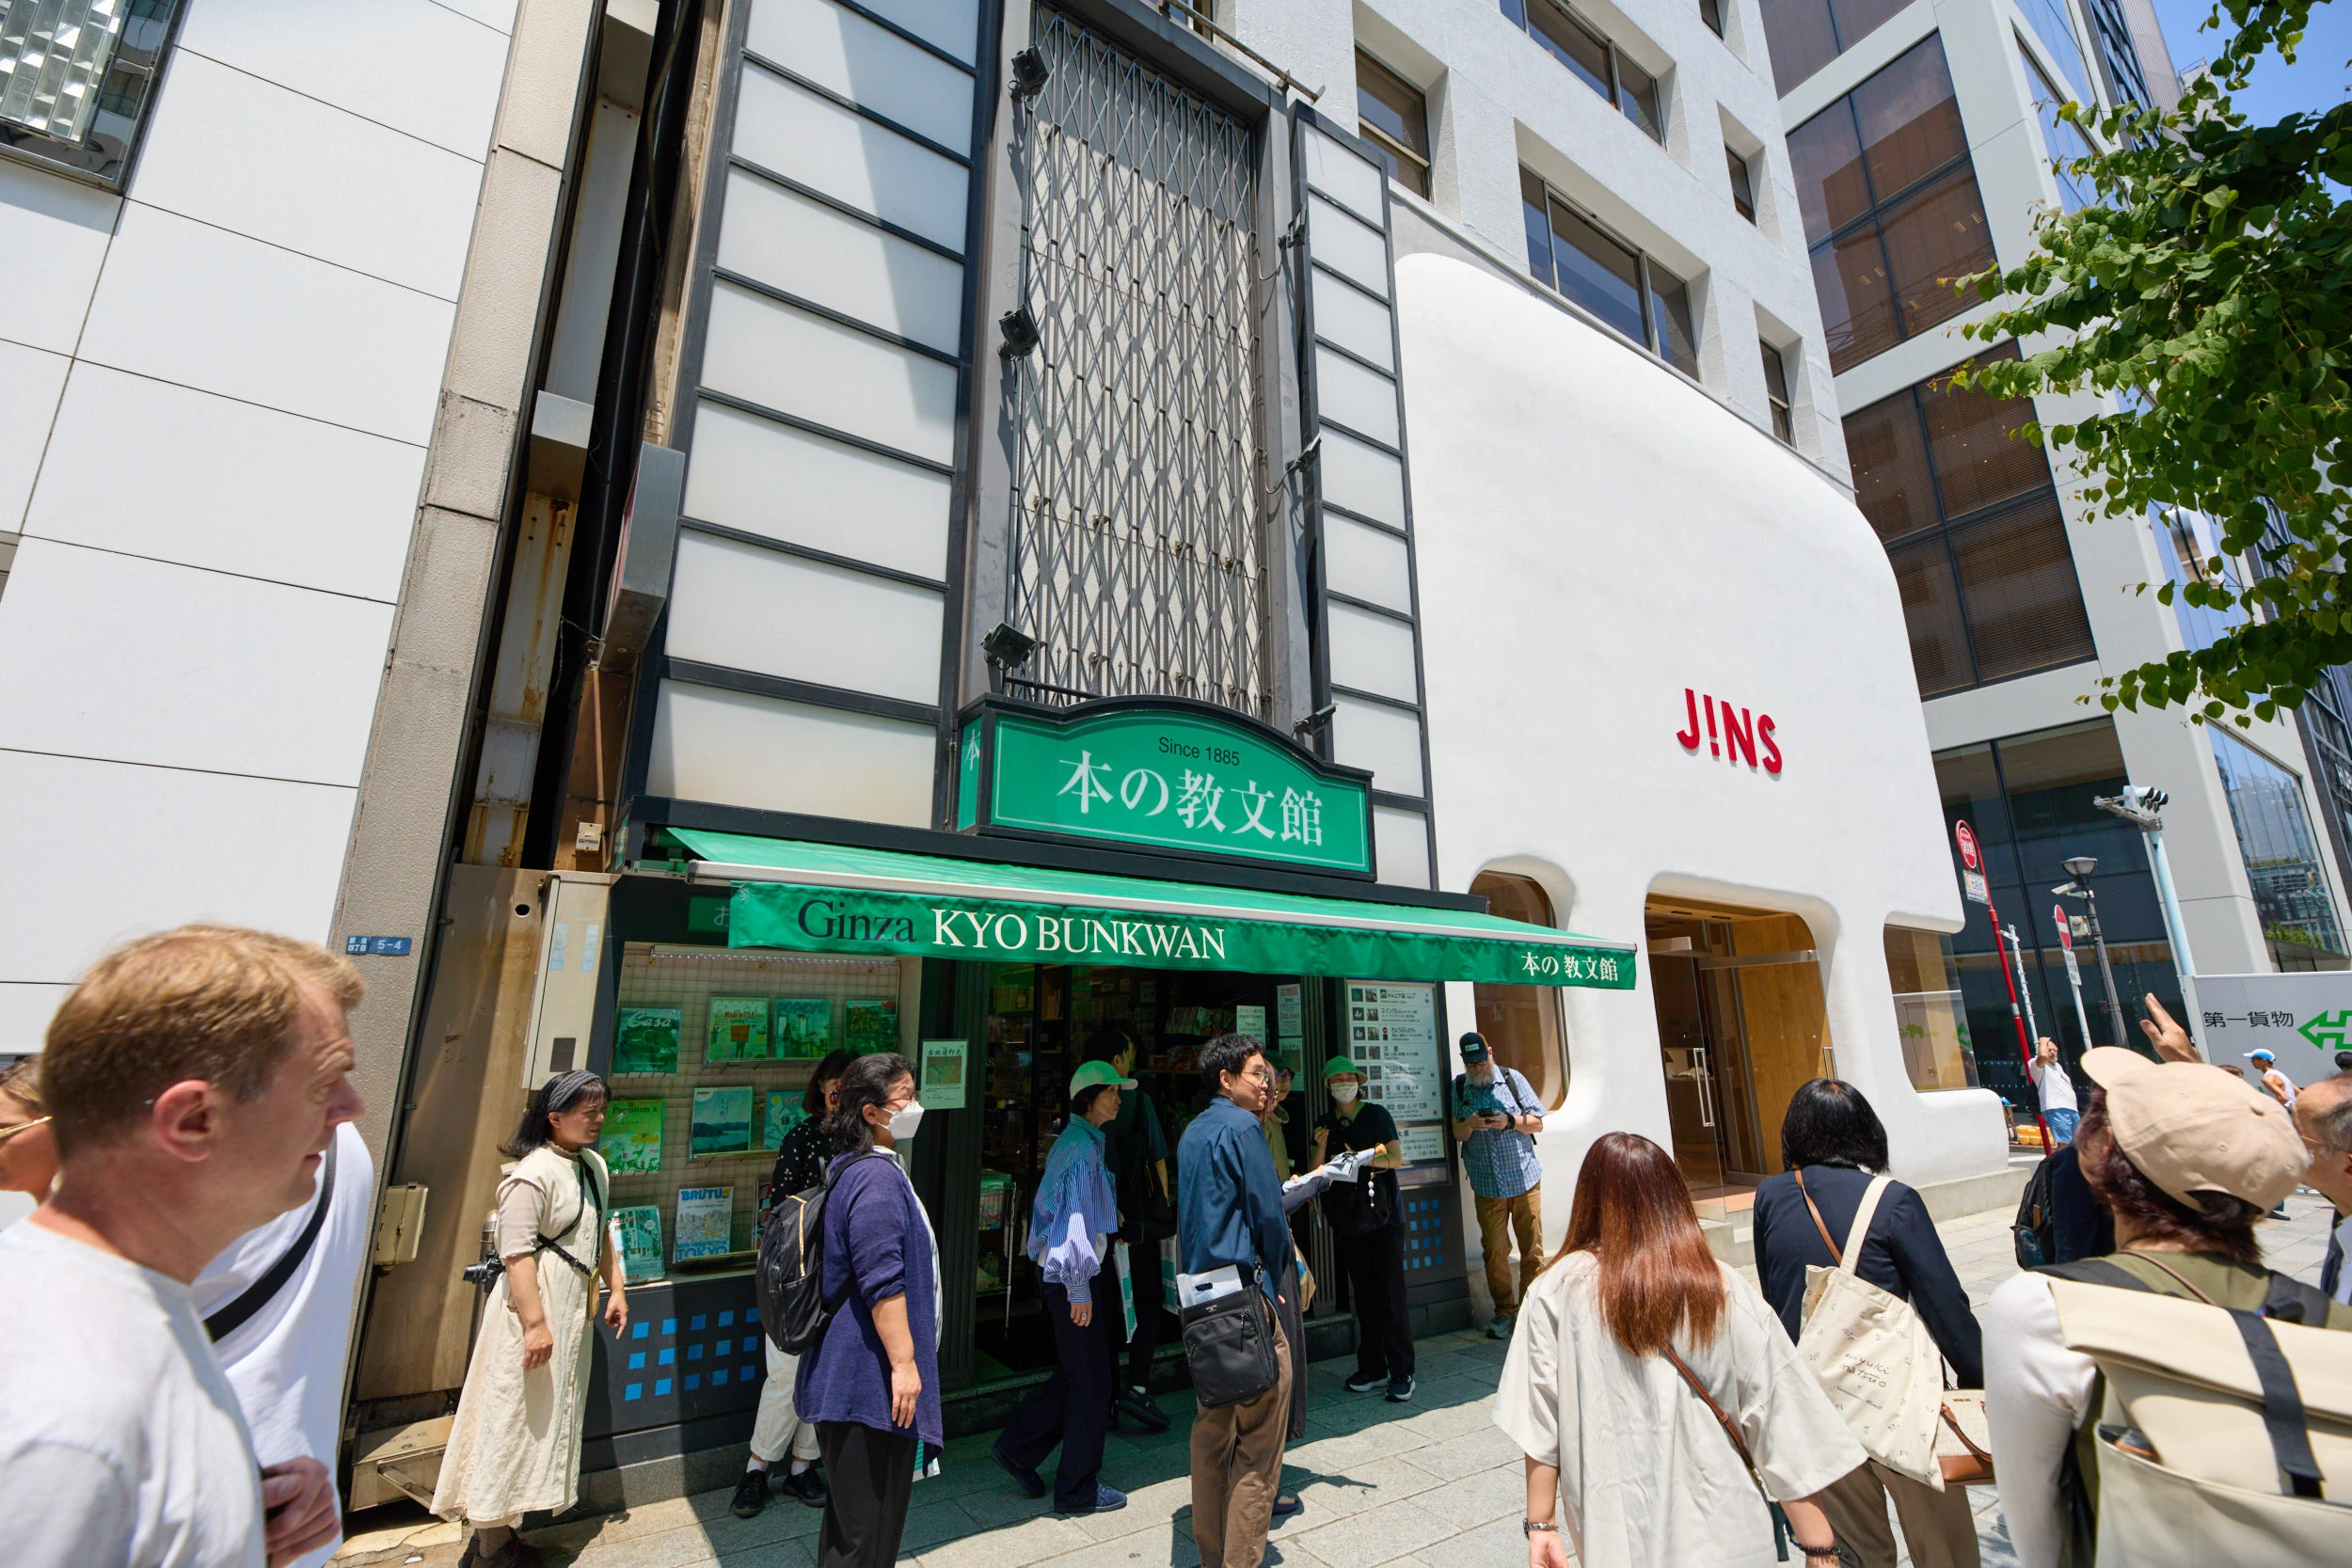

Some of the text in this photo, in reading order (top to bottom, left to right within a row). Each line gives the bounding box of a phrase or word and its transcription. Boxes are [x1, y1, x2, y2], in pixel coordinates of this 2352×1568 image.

[1158, 736, 1241, 767] Since 1885
[1057, 750, 1324, 847] 本の教文館
[798, 899, 916, 943] Ginza
[377, 940, 403, 951] 5-4
[1520, 951, 1619, 982] 本の教文館
[627, 1011, 673, 1028] Casa
[2202, 1010, 2294, 1028] 第一貨物
[612, 1105, 651, 1115] Premium
[677, 1244, 728, 1260] TOKYO
